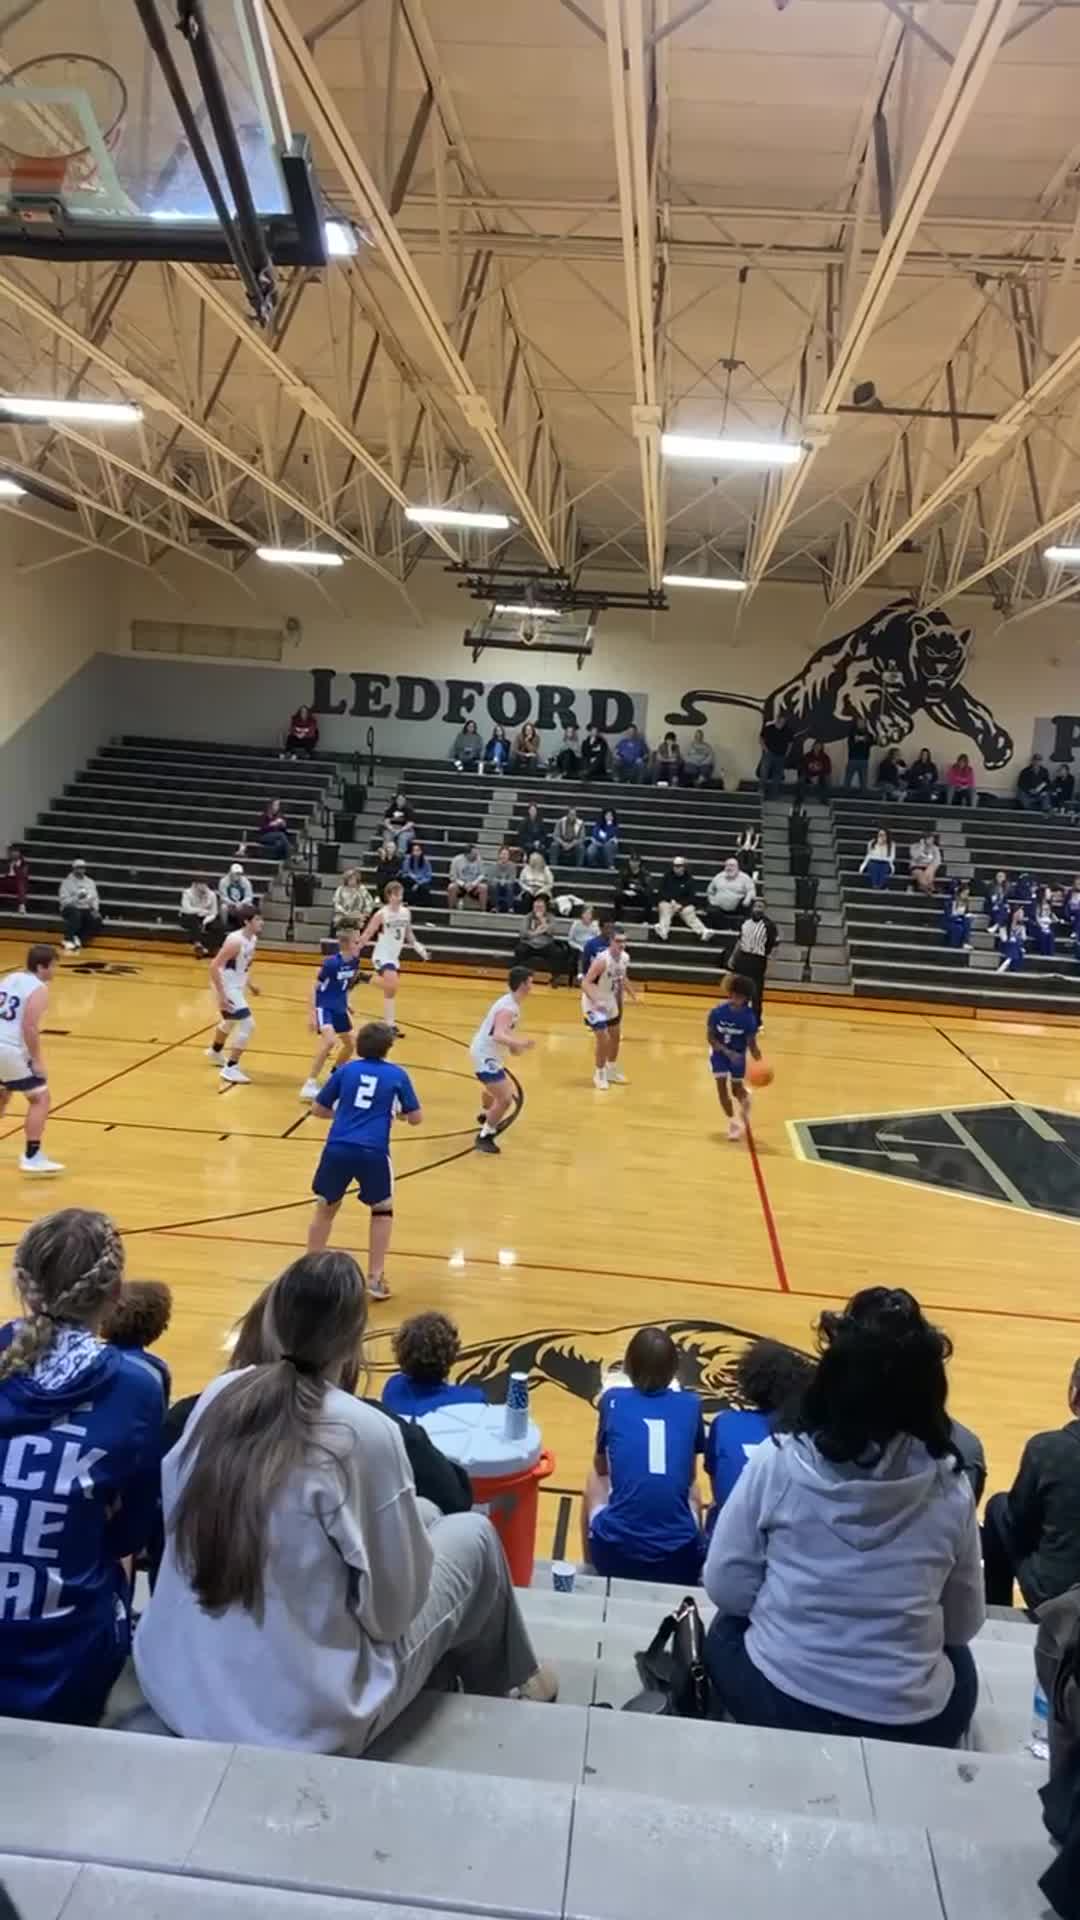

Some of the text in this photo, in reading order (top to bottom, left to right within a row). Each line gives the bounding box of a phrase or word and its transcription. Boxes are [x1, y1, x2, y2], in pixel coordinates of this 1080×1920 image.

[309, 668, 635, 734] LEDFORD
[354, 1074, 378, 1109] 2
[642, 1418, 666, 1474] 1
